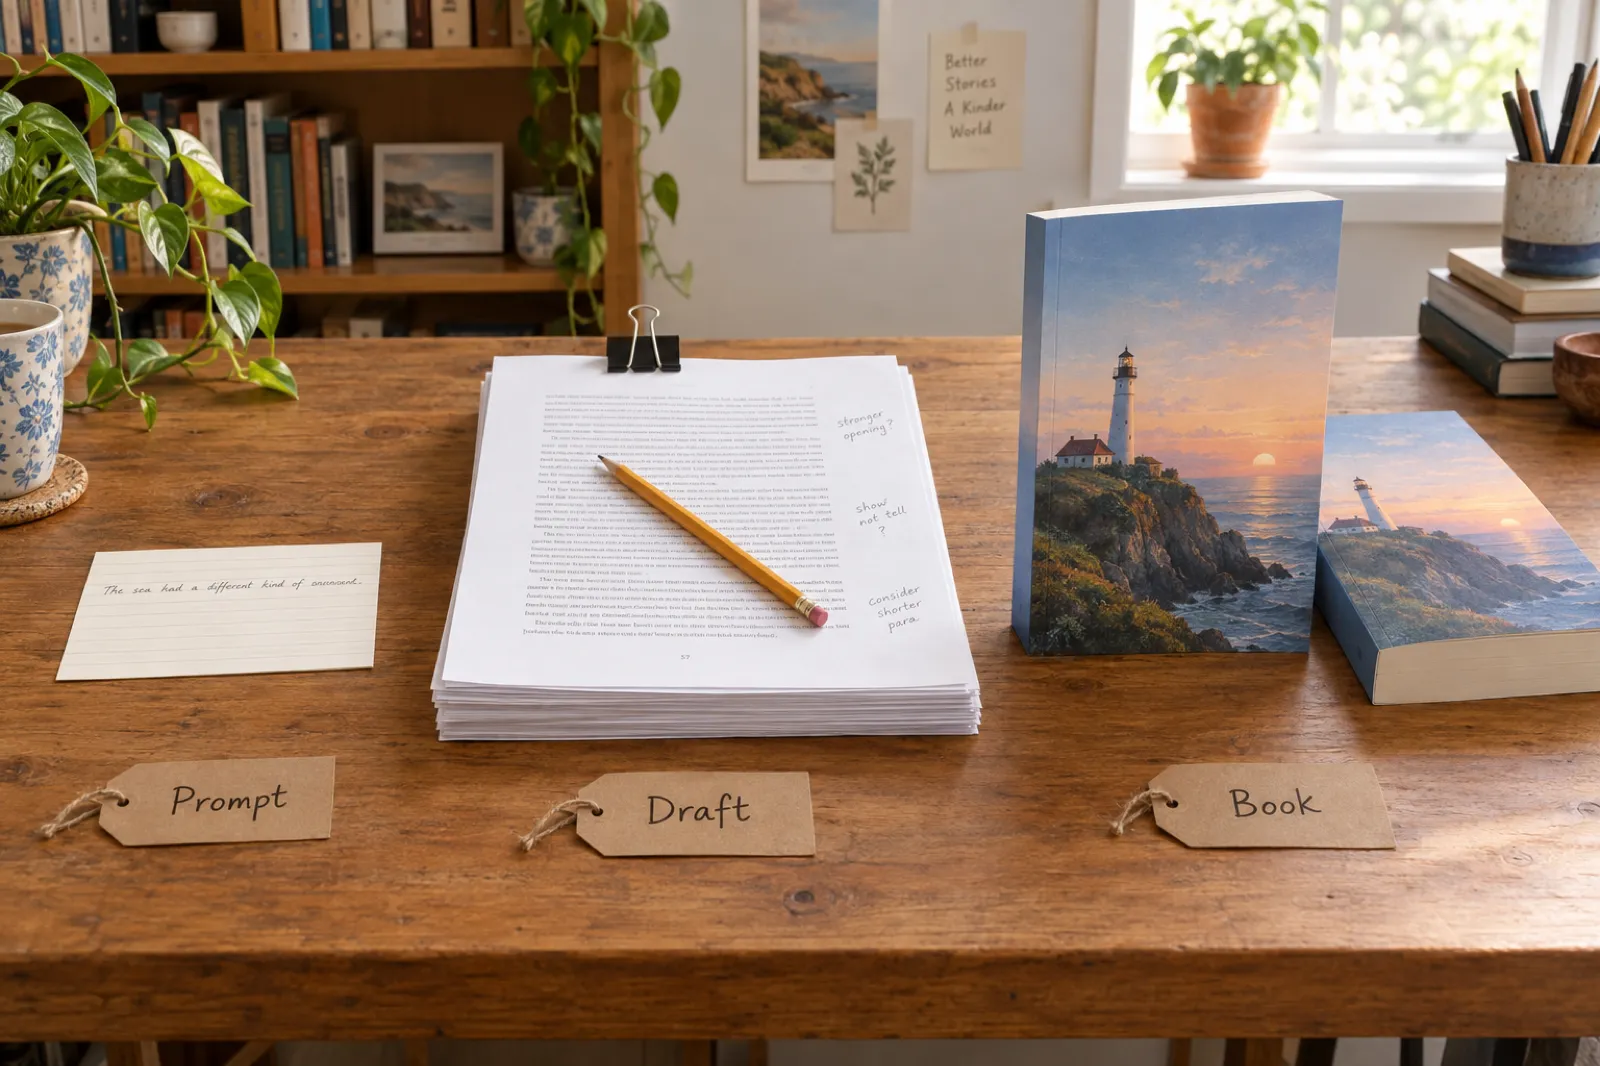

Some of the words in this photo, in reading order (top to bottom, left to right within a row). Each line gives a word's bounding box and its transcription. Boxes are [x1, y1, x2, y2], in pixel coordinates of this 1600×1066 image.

[944, 53, 988, 71] Better
[944, 76, 997, 92] Stories
[944, 101, 954, 117] A
[961, 97, 1006, 115] Kinder
[950, 120, 993, 138] World
[837, 410, 884, 428] stronger
[856, 498, 888, 514] show
[859, 513, 880, 526] not
[885, 505, 907, 519] tell
[878, 525, 886, 537] ?
[103, 584, 124, 596] The
[161, 583, 184, 593] had
[207, 580, 253, 595] different
[261, 579, 286, 589] kind
[291, 578, 305, 591] of
[877, 600, 922, 618] shorter
[171, 784, 288, 822] Prompt
[647, 792, 751, 829] Draft
[1228, 787, 1322, 818] Book
